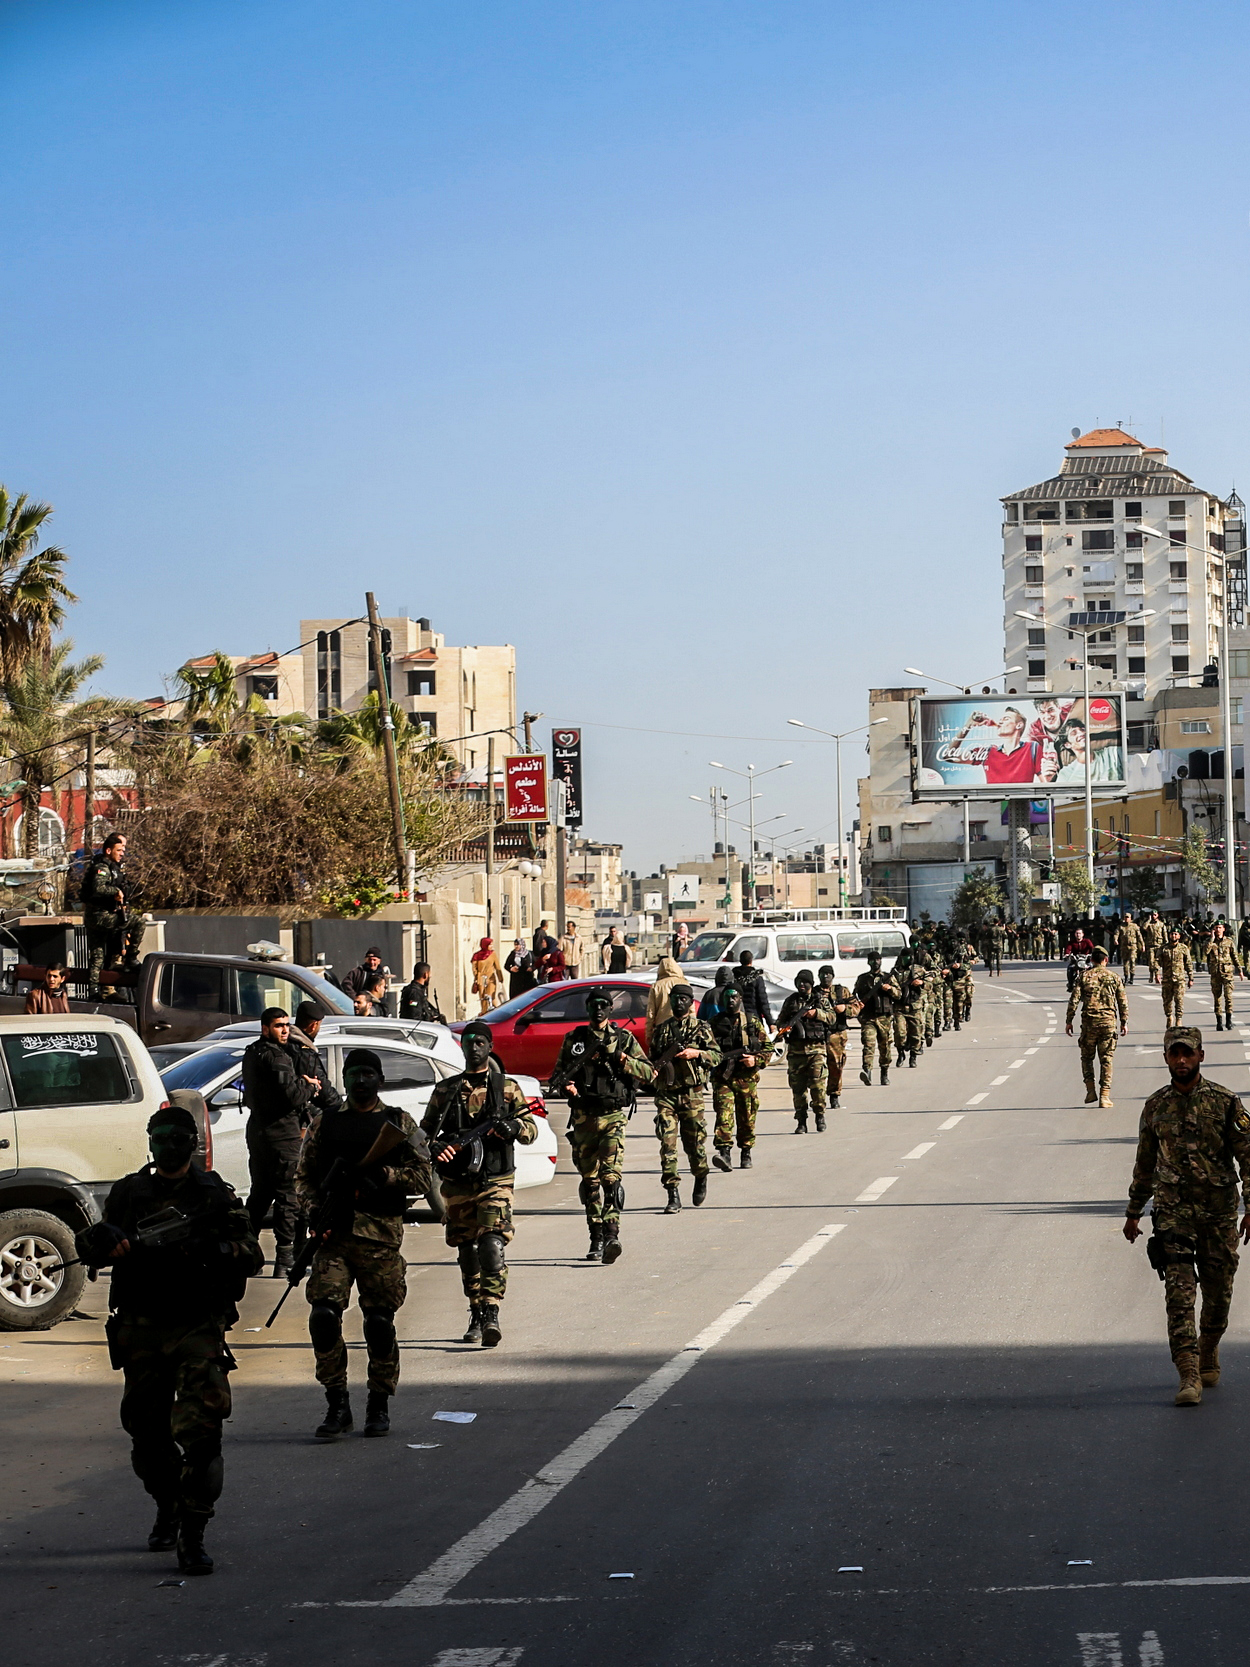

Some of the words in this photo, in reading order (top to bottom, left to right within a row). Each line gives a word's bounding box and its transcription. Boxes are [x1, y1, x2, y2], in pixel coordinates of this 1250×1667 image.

[555, 748, 577, 757] صالة
[936, 743, 988, 761] Coca-Cola
[509, 759, 542, 774] الأندلس
[515, 777, 536, 790] مطعم
[529, 804, 545, 813] صالة
